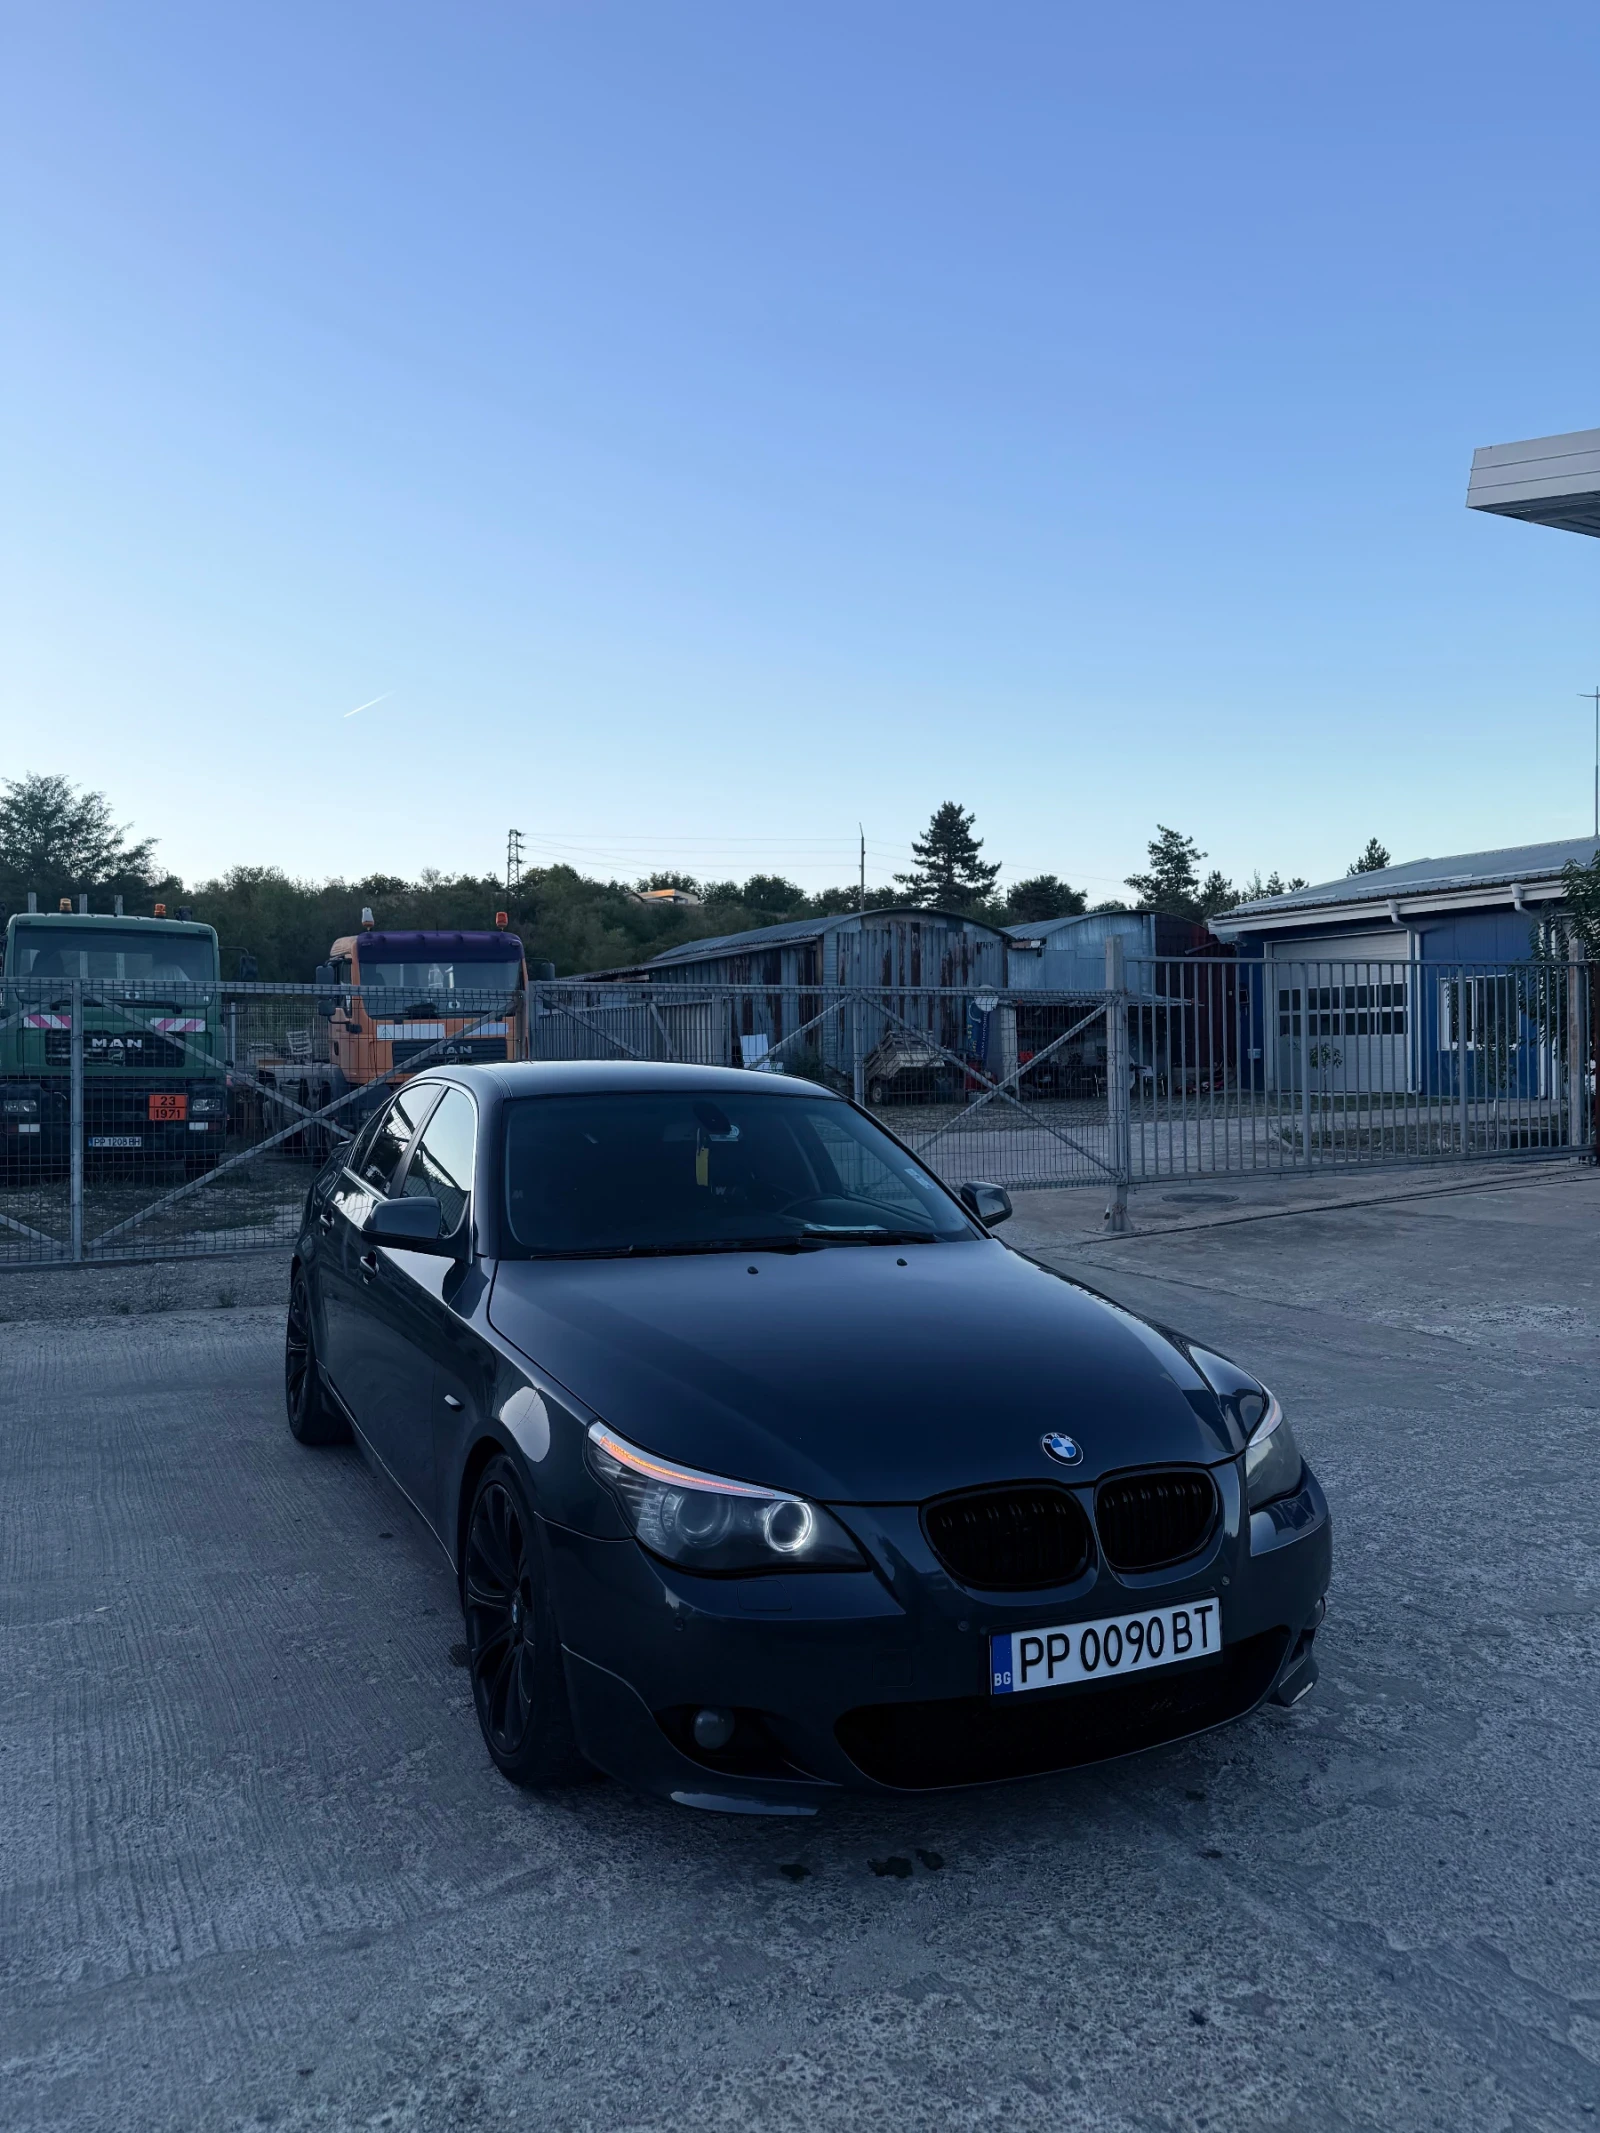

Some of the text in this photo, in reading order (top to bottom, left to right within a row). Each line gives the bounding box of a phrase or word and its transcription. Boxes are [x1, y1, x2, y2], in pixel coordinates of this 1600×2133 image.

[92, 1038, 142, 1048] MAN
[160, 1096, 176, 1106] 23
[155, 1109, 181, 1119] 1971
[94, 1138, 106, 1146] PP
[1020, 1604, 1214, 1684] PP 0090 BT
[994, 1671, 1012, 1687] BG
